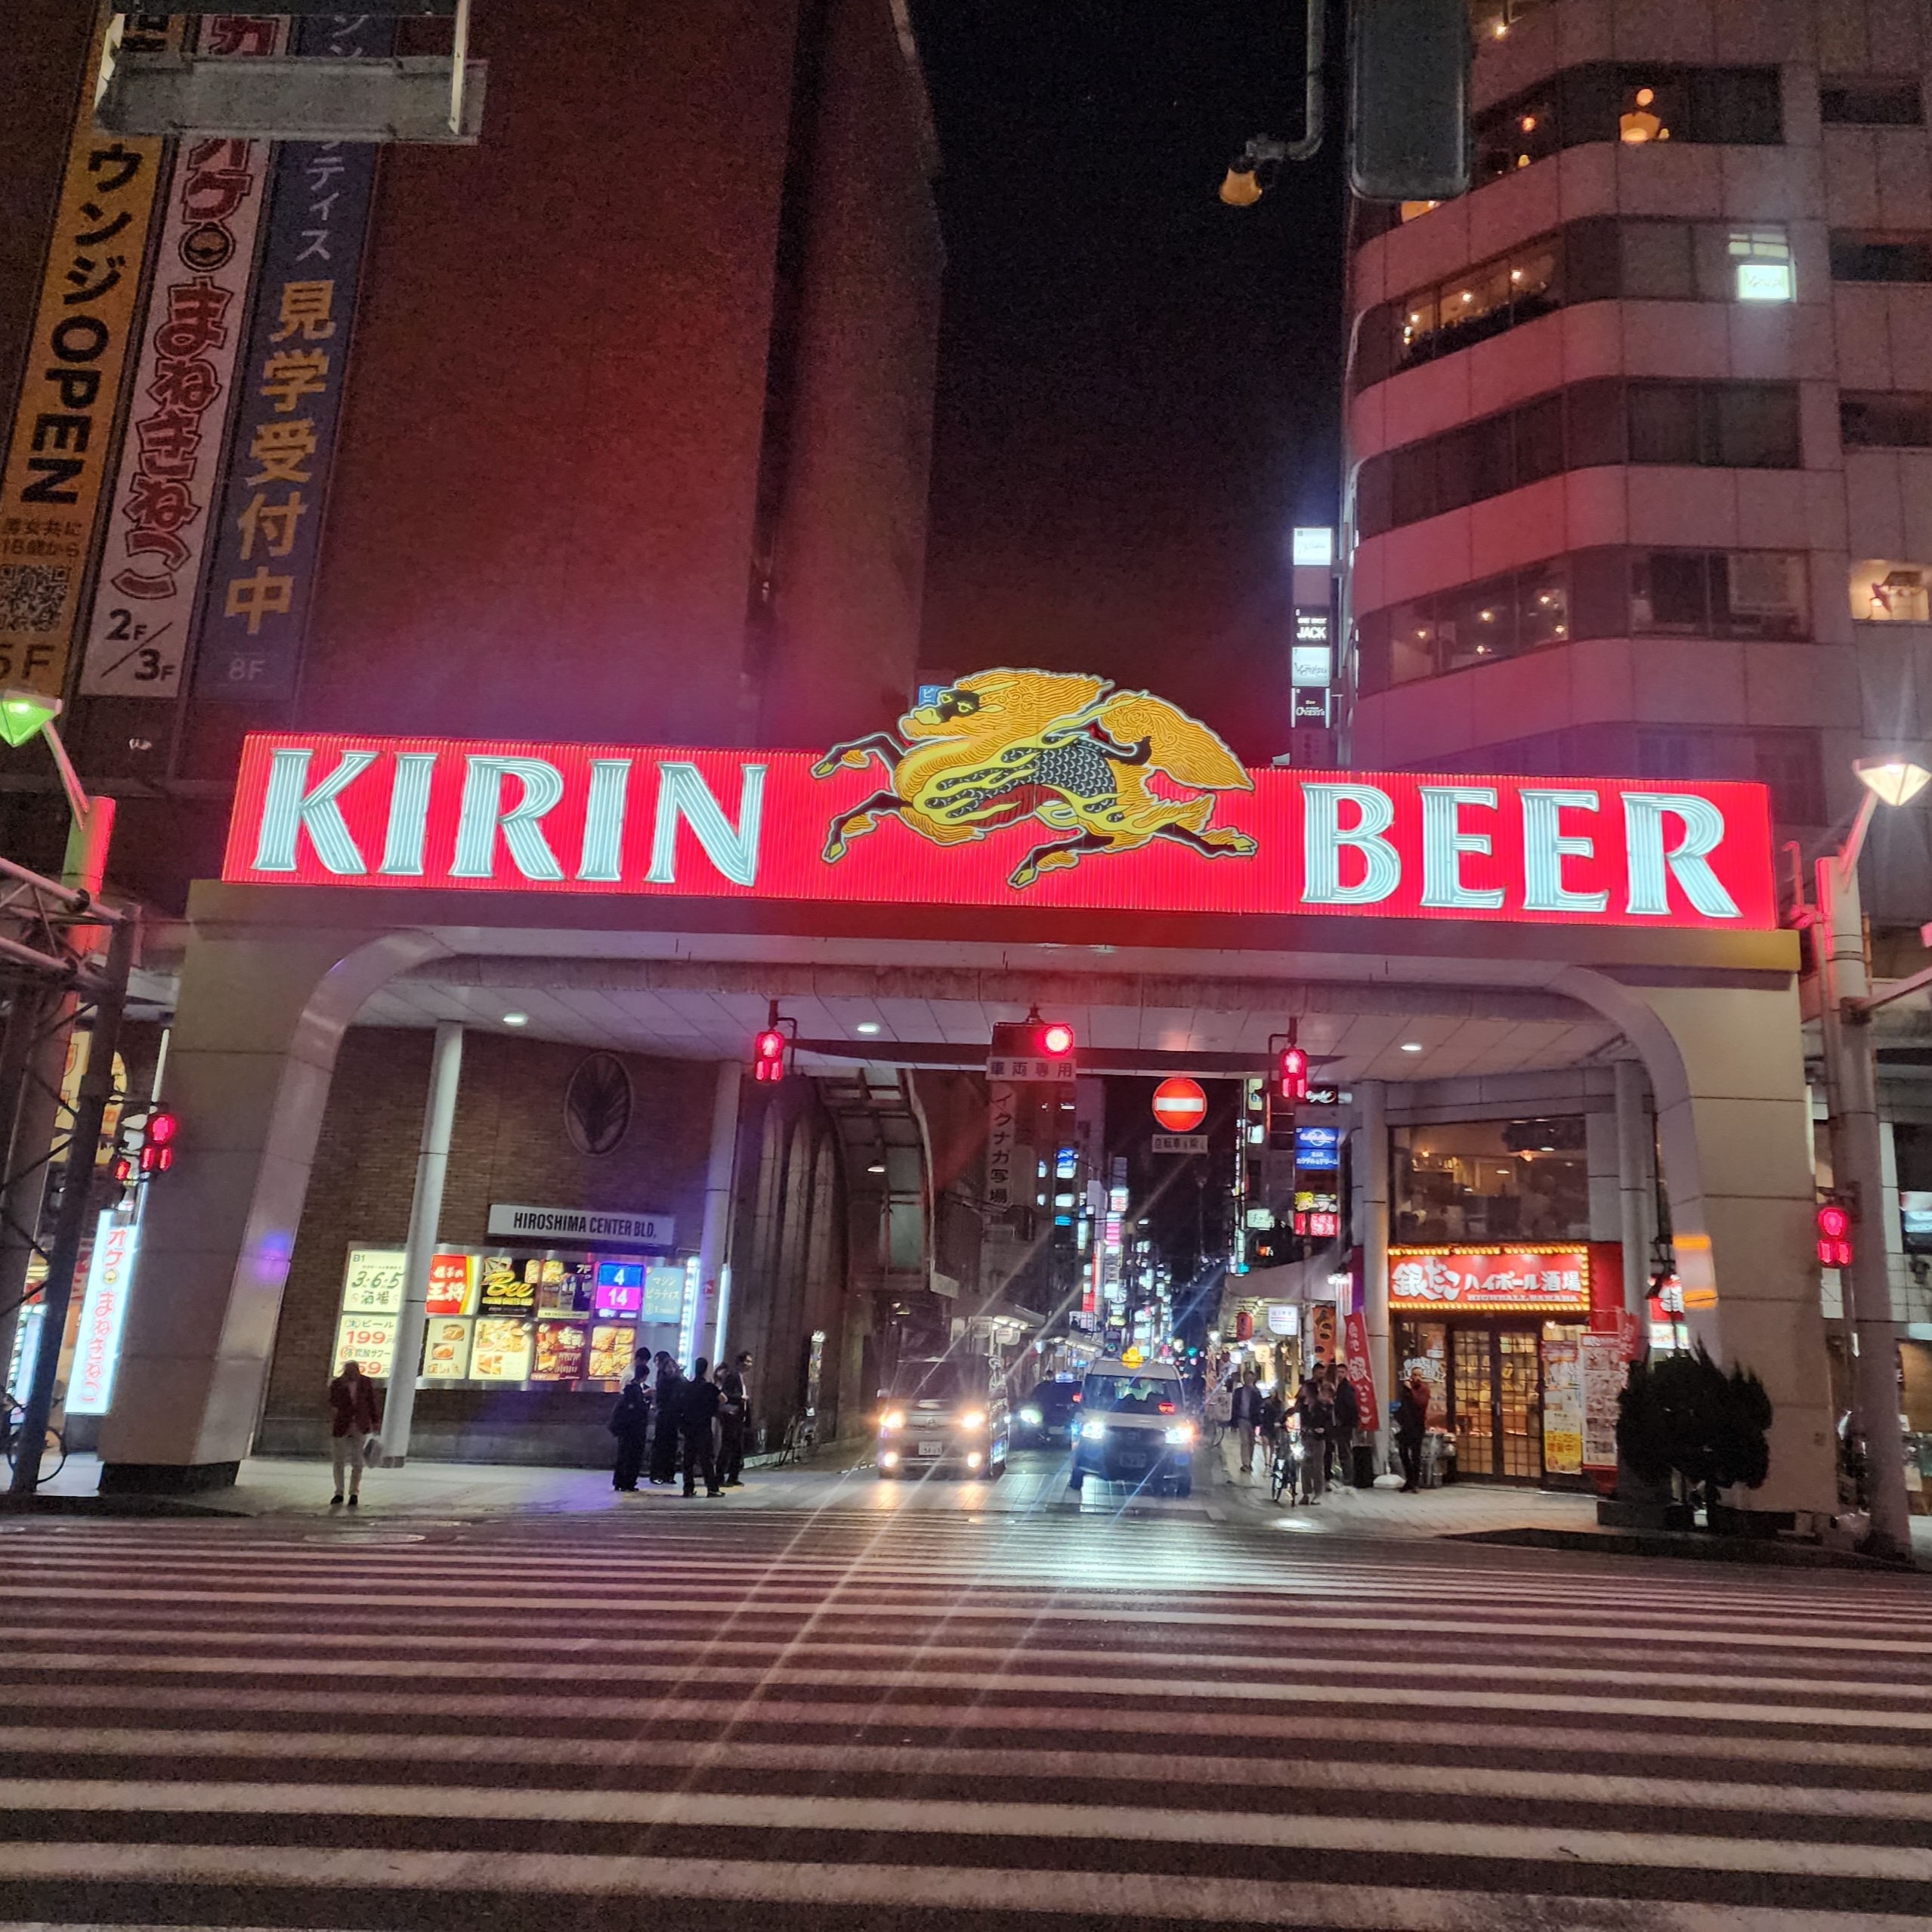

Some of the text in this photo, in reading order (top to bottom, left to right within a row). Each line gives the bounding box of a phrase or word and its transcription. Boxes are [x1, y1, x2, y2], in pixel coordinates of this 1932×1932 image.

[225, 280, 335, 635] 見学受付中
[1296, 626, 1327, 640] JACK
[229, 658, 266, 681] 8F
[252, 747, 1742, 920] KIRIN BEER
[513, 1212, 586, 1233] HIROSHIMA
[589, 1216, 632, 1236] CENTER
[576, 1264, 592, 1274] 7F
[614, 1269, 625, 1286] 4
[484, 1270, 534, 1298] Bee
[1392, 1260, 1583, 1301] 銀だこ ハイボール酒場
[426, 1282, 466, 1303] 王将
[608, 1287, 628, 1306] 14
[646, 1289, 679, 1300] ピラティス
